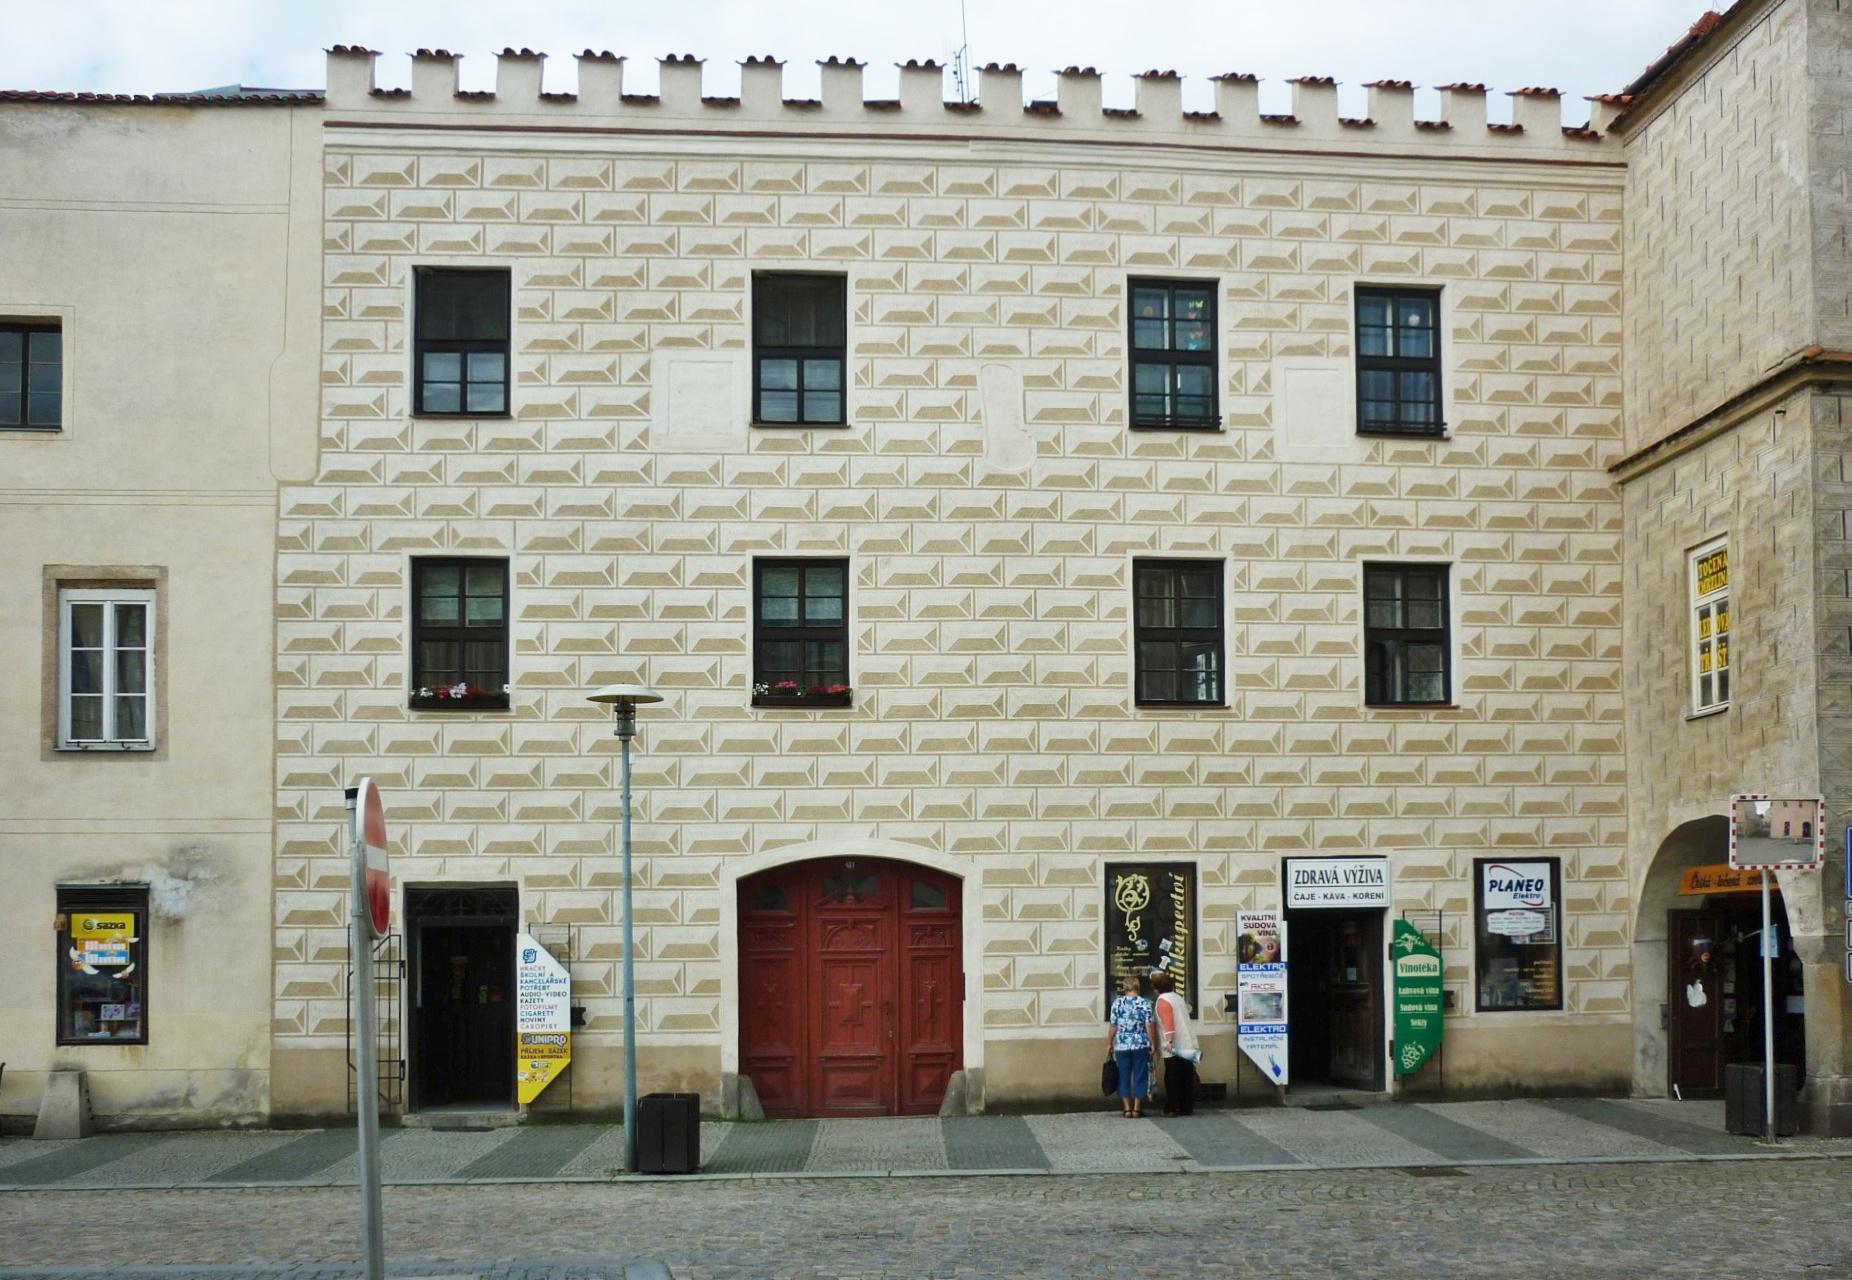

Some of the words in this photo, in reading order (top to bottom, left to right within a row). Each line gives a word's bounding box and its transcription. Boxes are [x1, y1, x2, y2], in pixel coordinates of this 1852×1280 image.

[1294, 865, 1339, 884] ZDRAVÁ
[1343, 864, 1383, 884] VÝŽIVA
[1488, 879, 1544, 892] PLANEO
[1353, 891, 1384, 900] KOŘENÍ
[1168, 872, 1189, 1001] nihkupectví
[1240, 963, 1286, 971] ELEKTRO
[531, 1034, 567, 1046] UNIPRO
